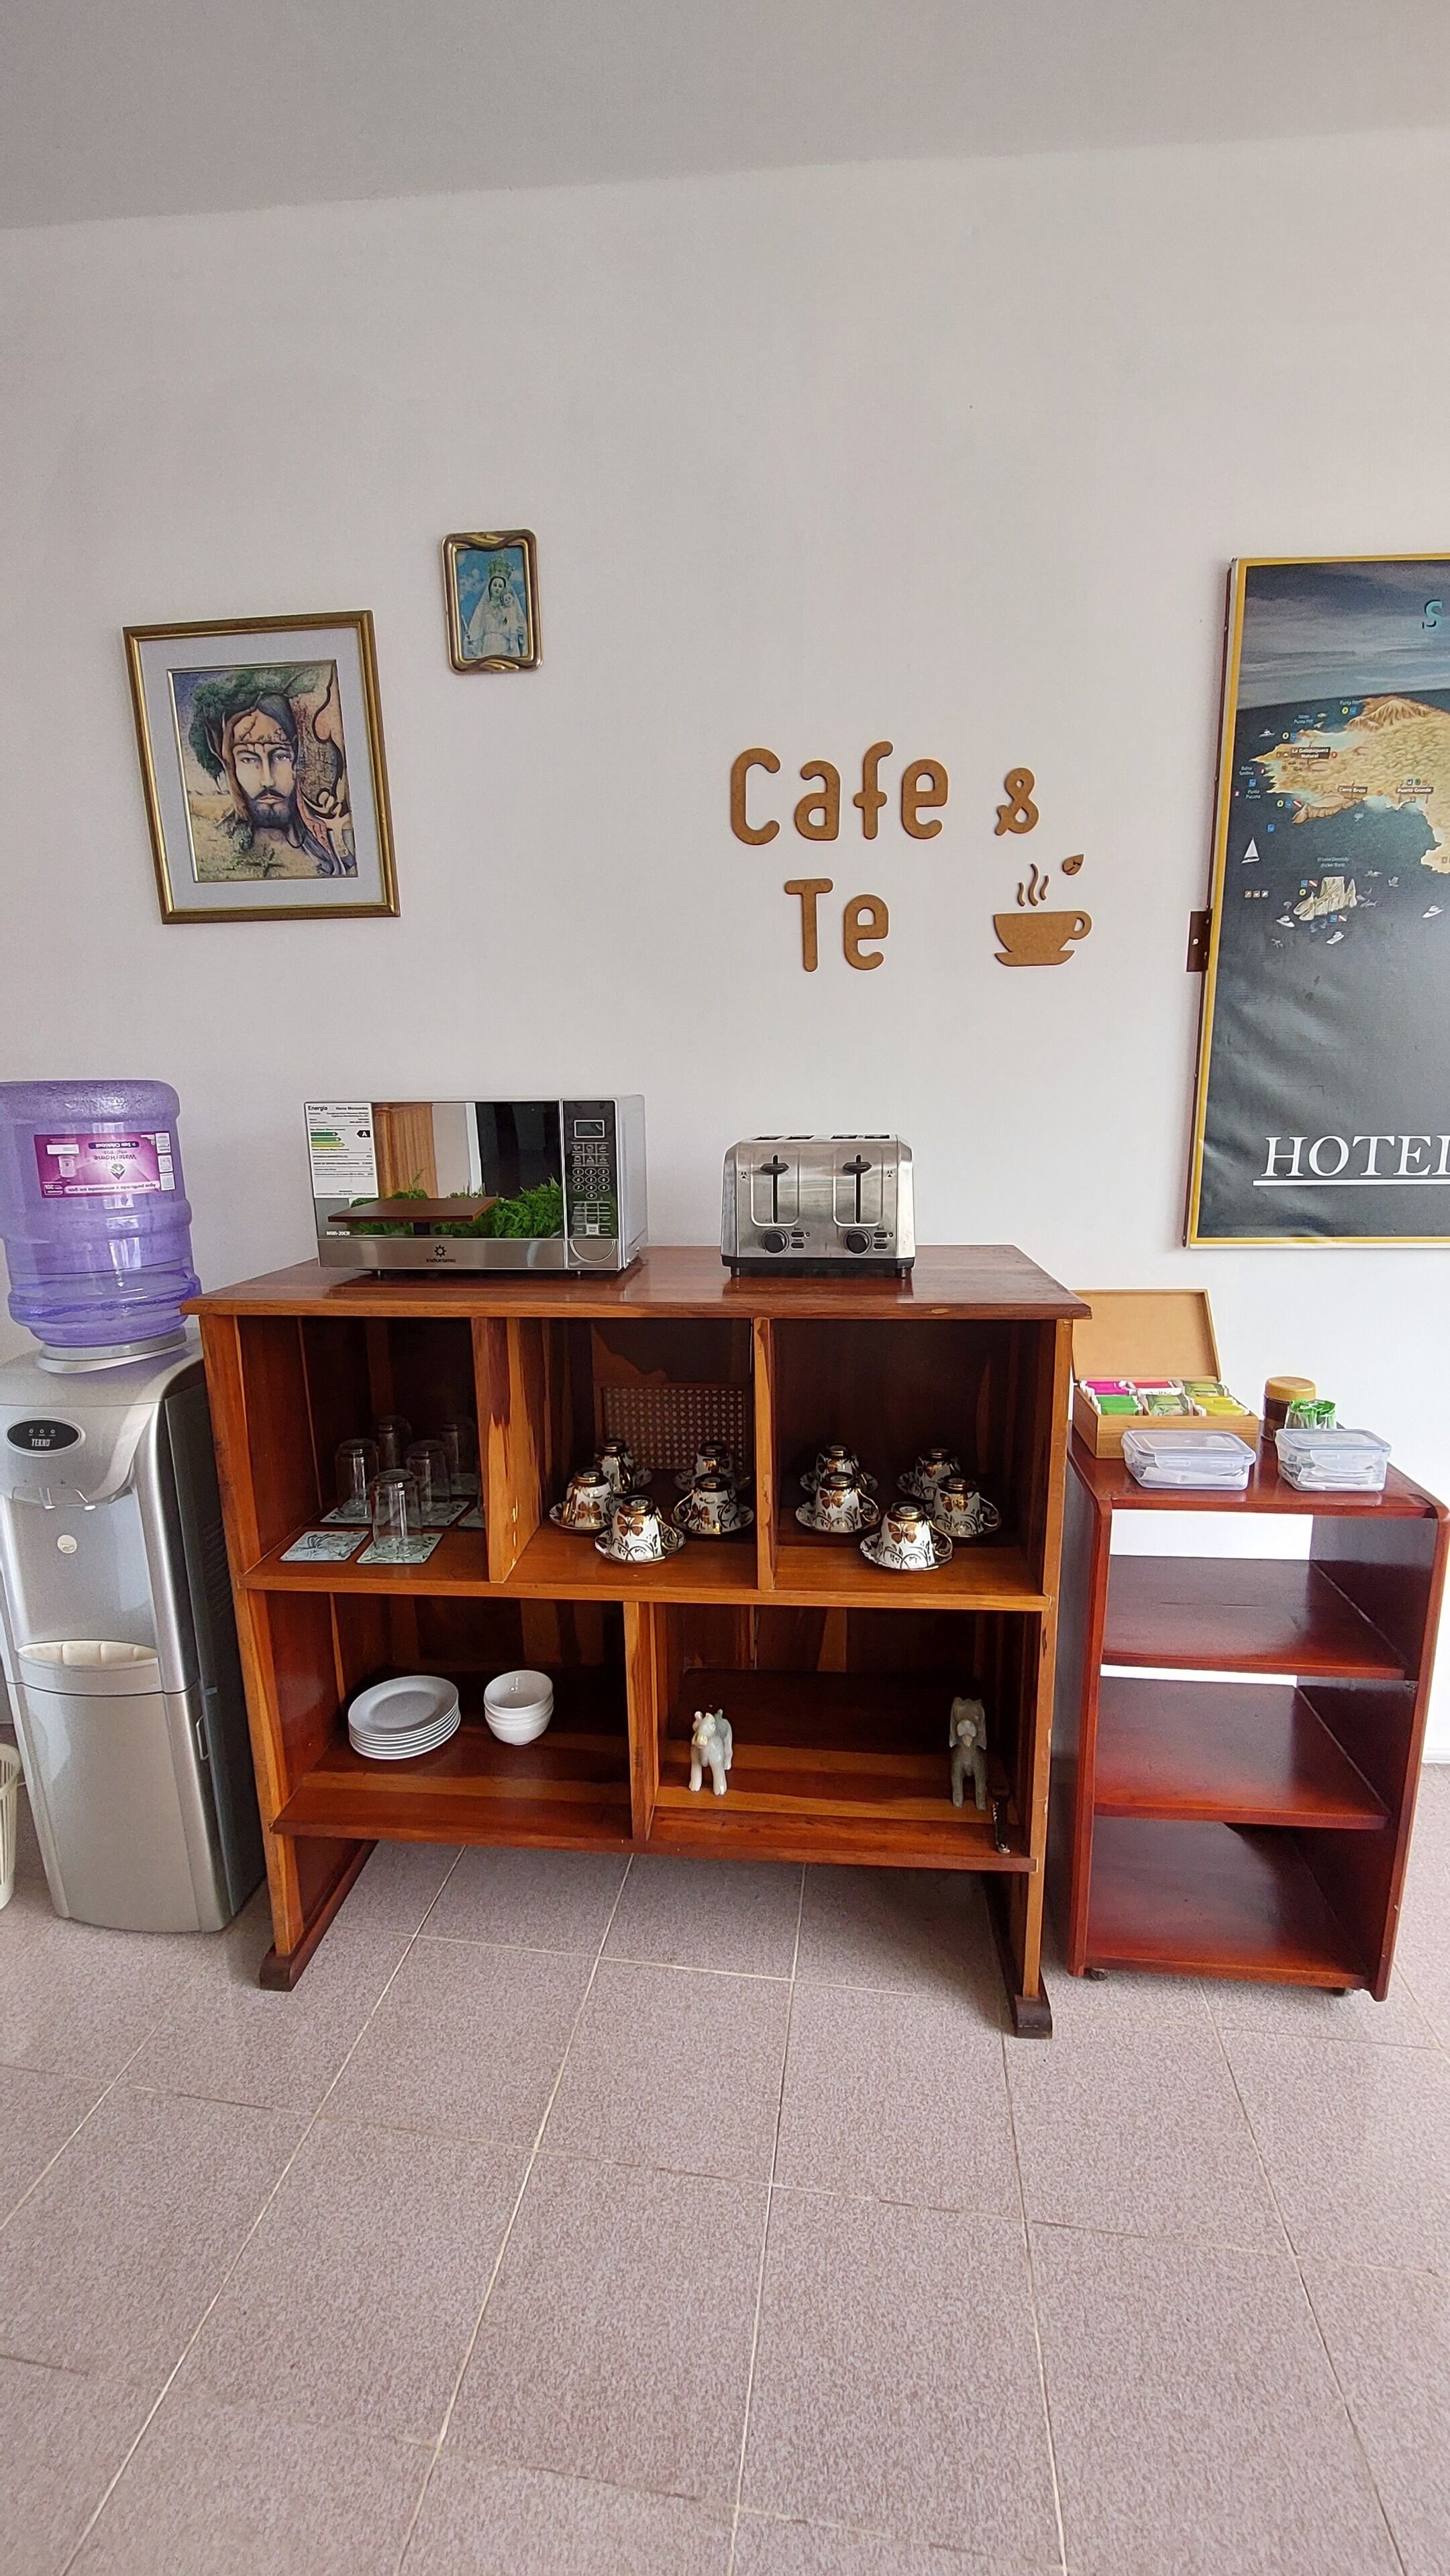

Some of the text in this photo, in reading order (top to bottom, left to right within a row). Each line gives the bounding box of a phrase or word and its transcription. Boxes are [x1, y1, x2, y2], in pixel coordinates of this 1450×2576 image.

[731, 741, 1039, 845] Cafe &
[784, 877, 889, 973] Te
